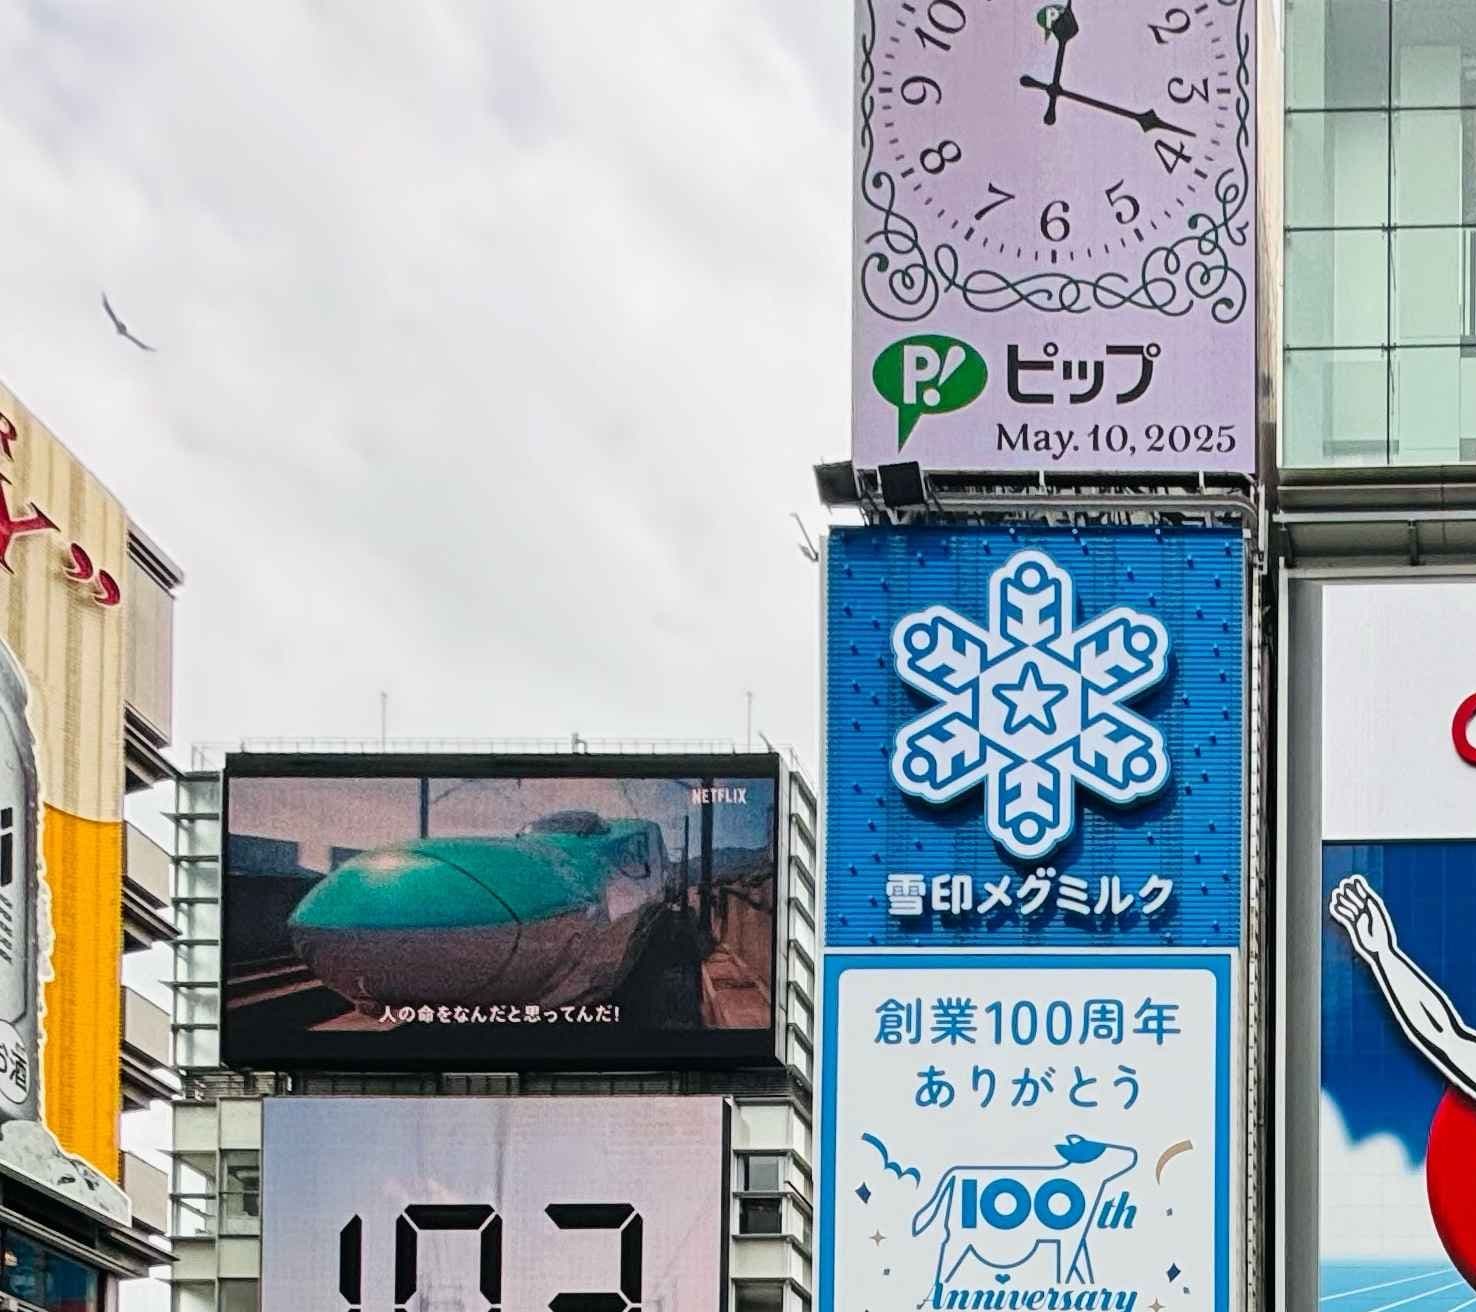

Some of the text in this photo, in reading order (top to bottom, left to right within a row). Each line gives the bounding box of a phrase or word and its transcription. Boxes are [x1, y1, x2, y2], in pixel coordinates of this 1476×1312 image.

[915, 0, 966, 51] 10
[1147, 8, 1191, 44] 2
[900, 76, 942, 106] 9
[1167, 77, 1210, 104] 3
[919, 140, 961, 175] 8
[1154, 139, 1192, 174] 4
[974, 183, 1015, 221] 7
[1040, 201, 1070, 241] 6
[1105, 179, 1140, 224] 5
[1007, 342, 1162, 405] ピップ
[996, 423, 1236, 459] May. 10, 2025
[692, 787, 748, 805] NETFLIX
[886, 867, 1174, 917] 雪印メグミルク
[873, 997, 1182, 1046] 創業100周年
[914, 1065, 1140, 1110] ありがとう
[961, 1177, 1137, 1231] 100th
